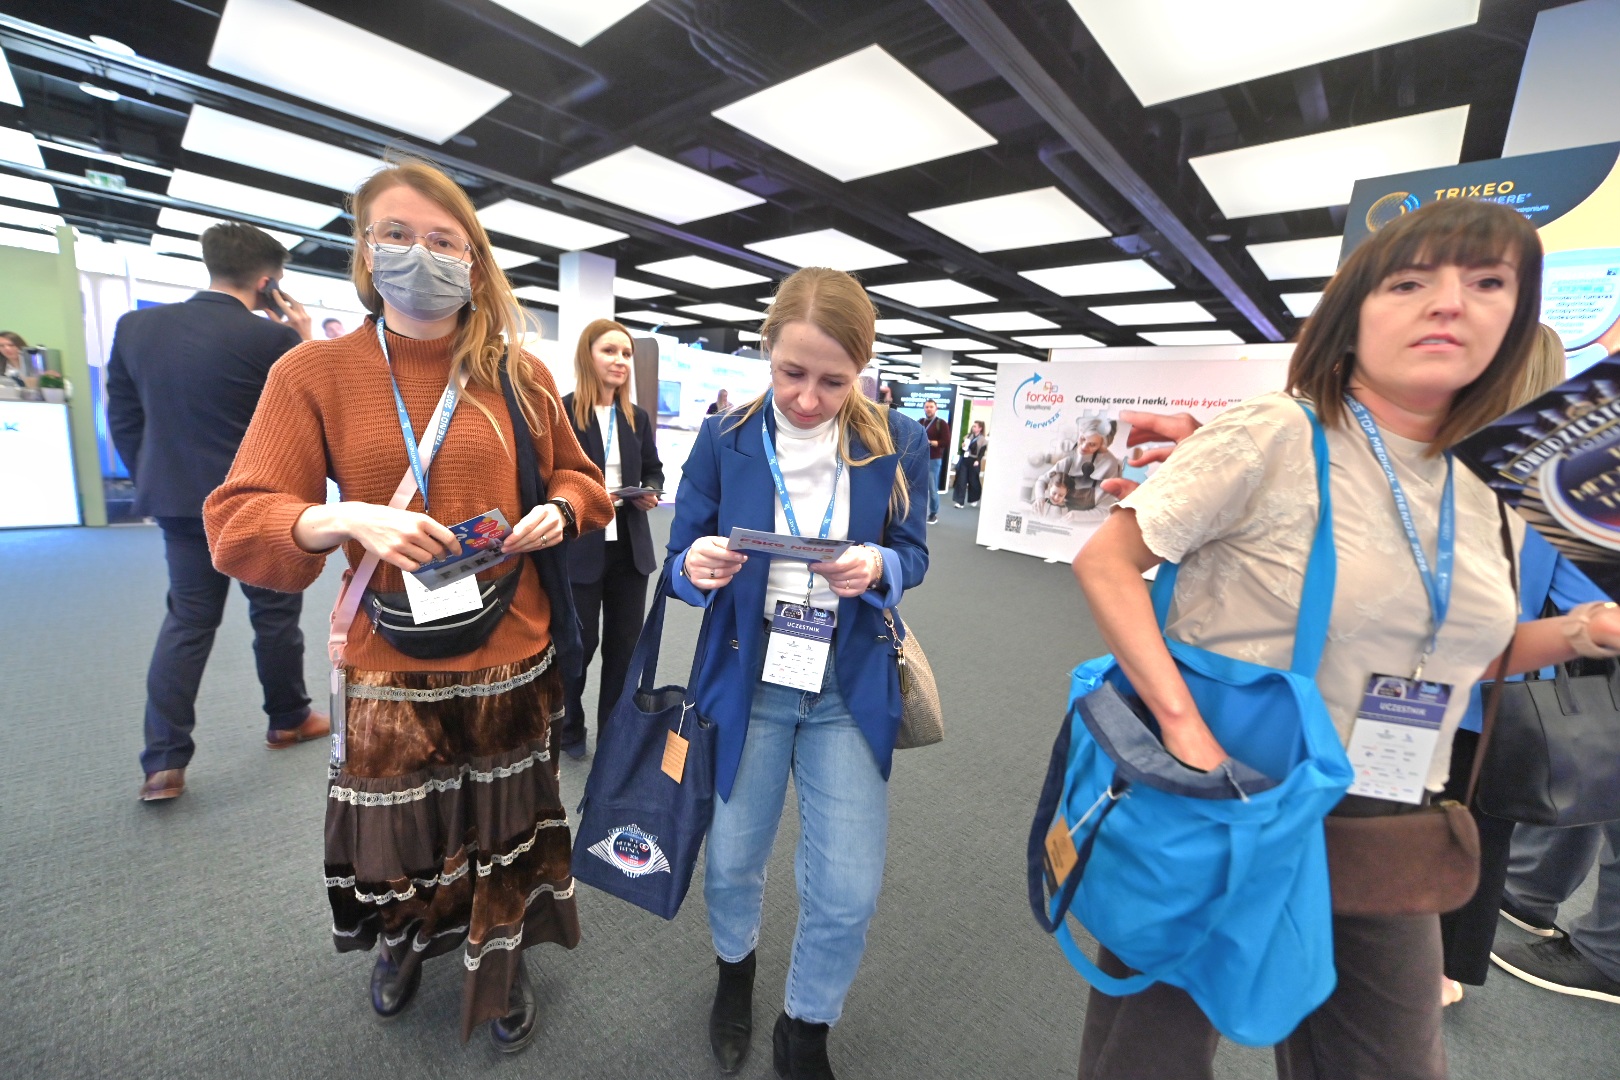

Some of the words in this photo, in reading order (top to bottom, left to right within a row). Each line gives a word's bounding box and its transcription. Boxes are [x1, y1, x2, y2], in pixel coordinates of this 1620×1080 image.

[1434, 180, 1515, 201] TRIXEO
[1026, 391, 1064, 406] forxiga
[1075, 394, 1111, 406] Chroniąc
[1112, 397, 1135, 405] serce
[1136, 396, 1141, 405] i
[1142, 396, 1168, 407] nerki,
[1170, 398, 1199, 408] ratuje
[1201, 398, 1228, 409] życie
[435, 410, 450, 446] TRENDS
[445, 389, 455, 409] 2026
[1025, 412, 1060, 429] Pierwsza
[1358, 413, 1376, 436] TOP
[1370, 436, 1396, 484] MEDICAL
[1392, 486, 1415, 538] TRENDS
[1411, 543, 1427, 572] 2026
[787, 621, 820, 633] UCZESTNIK
[1379, 702, 1427, 716] UCZESTNIK
